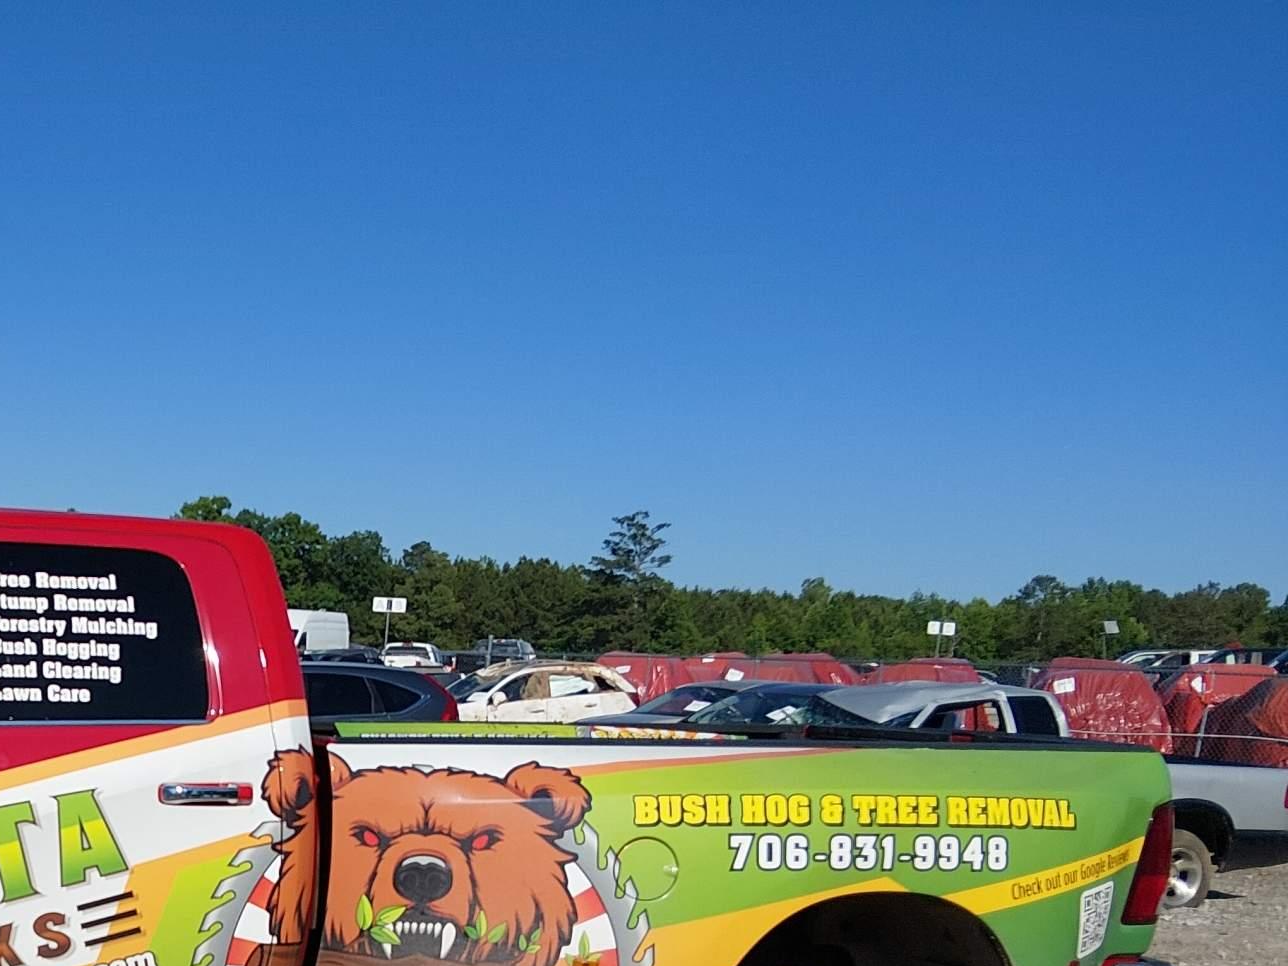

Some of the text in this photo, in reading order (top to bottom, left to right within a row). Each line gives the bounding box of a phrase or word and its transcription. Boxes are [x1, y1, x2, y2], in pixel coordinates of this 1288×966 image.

[35, 572, 117, 590] Removal
[53, 594, 135, 613] Removal
[71, 616, 158, 639] Mulching
[42, 638, 120, 660] Hogging
[42, 661, 122, 684] Clearing
[47, 684, 91, 702] Care
[633, 795, 1078, 829] BUSH HOG & TREE REMOVAL
[729, 833, 1009, 872] 706-831-9948
[1011, 878, 1043, 901] Check
[1046, 873, 1061, 891] out
[1064, 870, 1078, 885] our
[1081, 859, 1107, 878] Google
